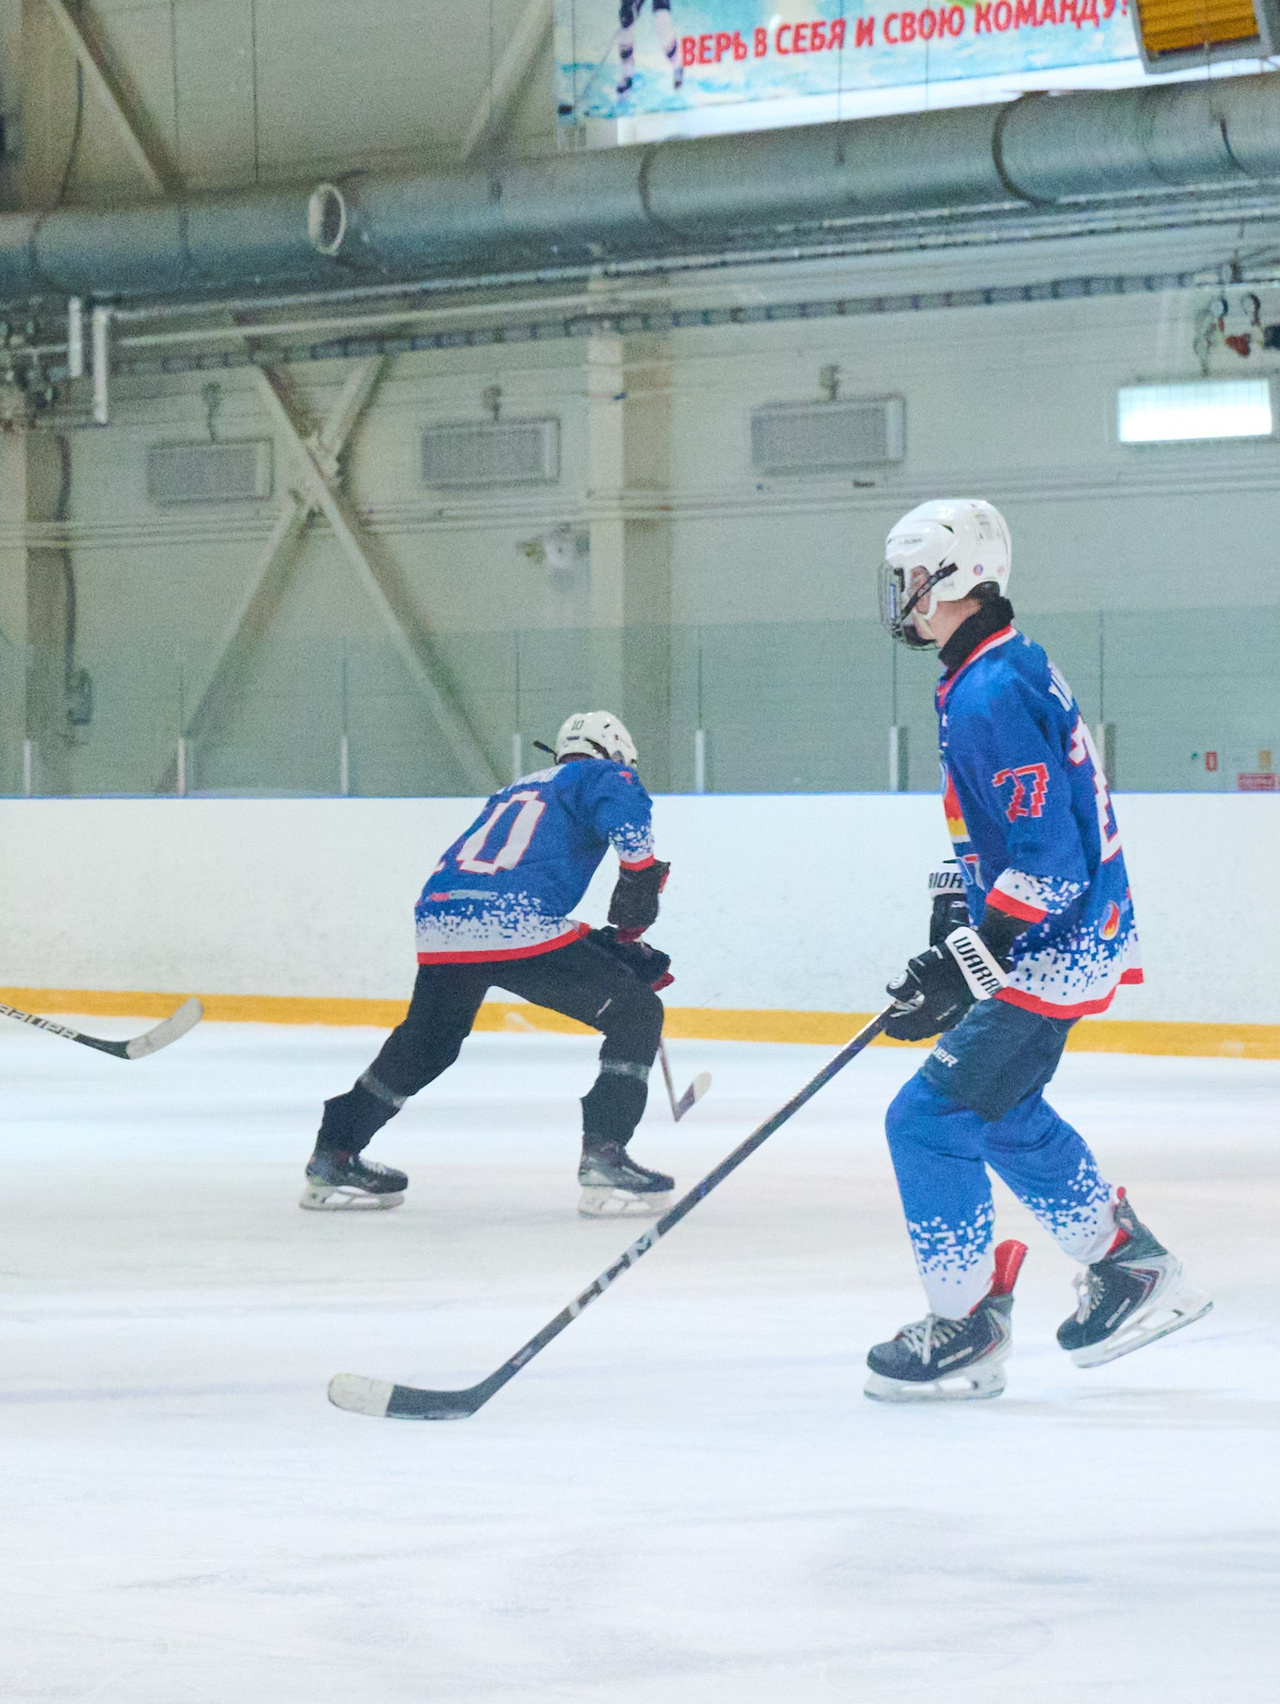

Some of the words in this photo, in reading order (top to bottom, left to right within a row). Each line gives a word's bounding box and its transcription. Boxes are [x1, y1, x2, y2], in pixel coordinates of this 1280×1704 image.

[681, 31, 747, 67] ВЕРЬ
[753, 27, 767, 58] В
[775, 18, 846, 55] СЕБЯ
[854, 16, 874, 47] И
[883, 6, 965, 44] СВОЮ
[991, 762, 1051, 823] 27
[433, 790, 547, 876] 0
